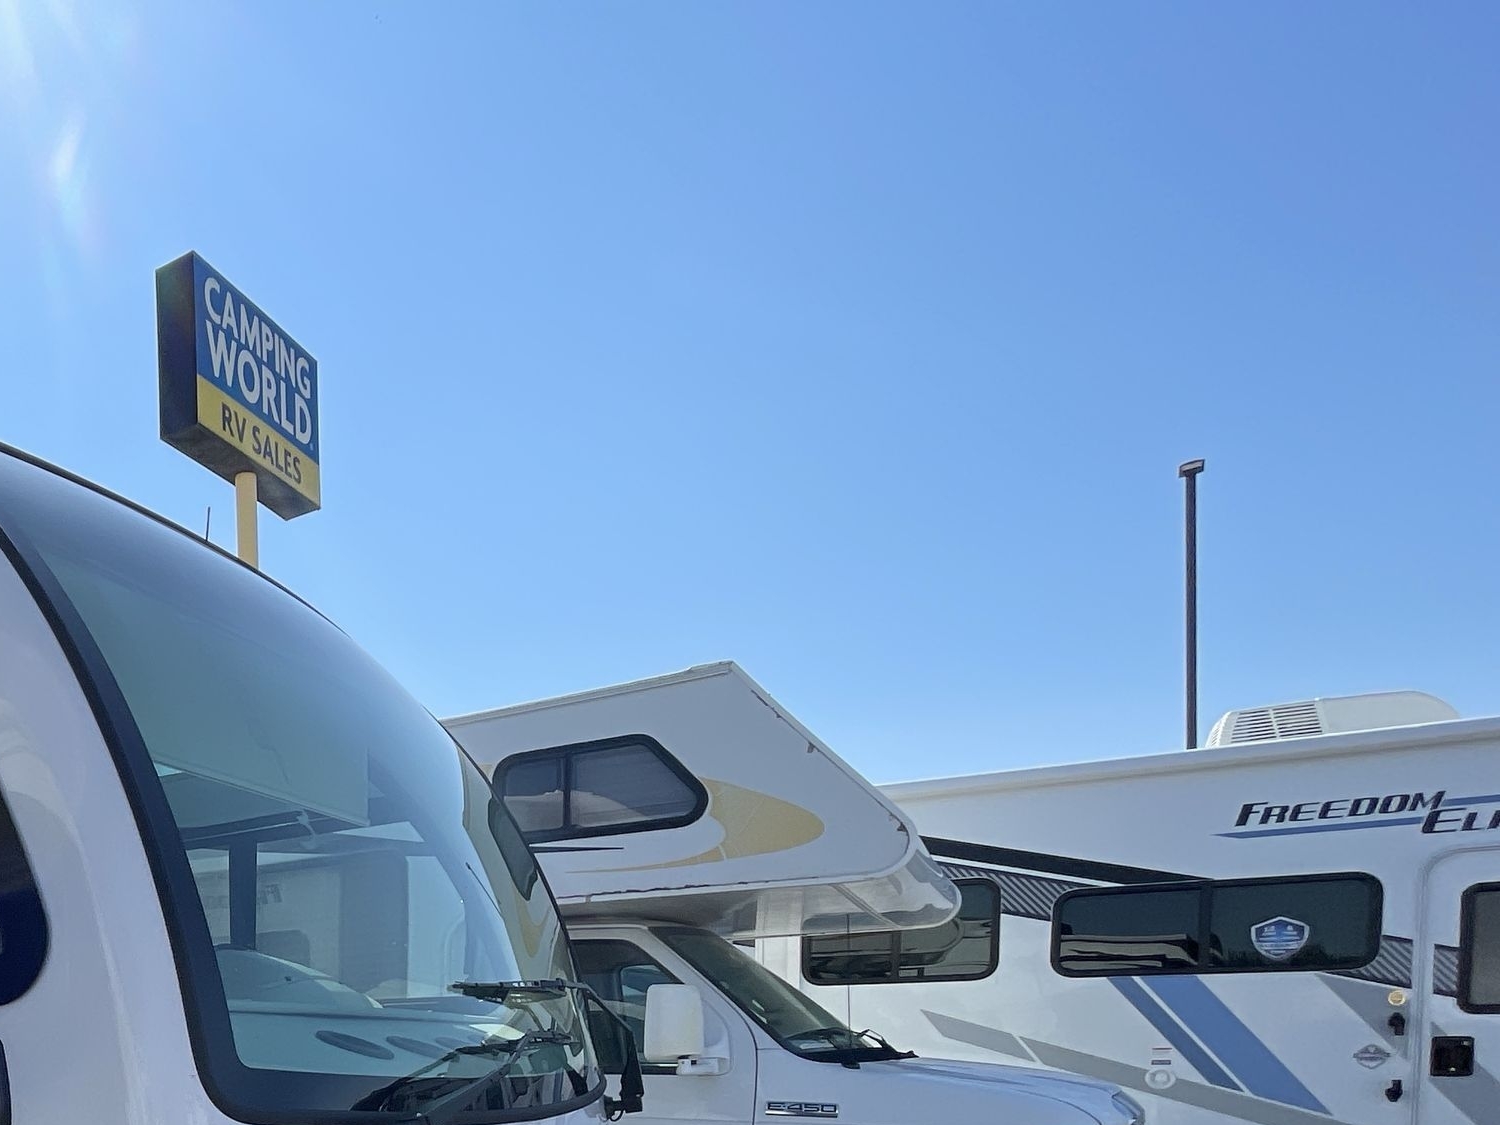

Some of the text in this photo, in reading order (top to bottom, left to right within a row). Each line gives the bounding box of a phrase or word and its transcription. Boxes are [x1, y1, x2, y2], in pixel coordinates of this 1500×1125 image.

[204, 277, 311, 399] CAMPING
[205, 320, 312, 445] WORLD
[221, 402, 302, 484] RV SALES
[1235, 791, 1446, 827] FREEDOM
